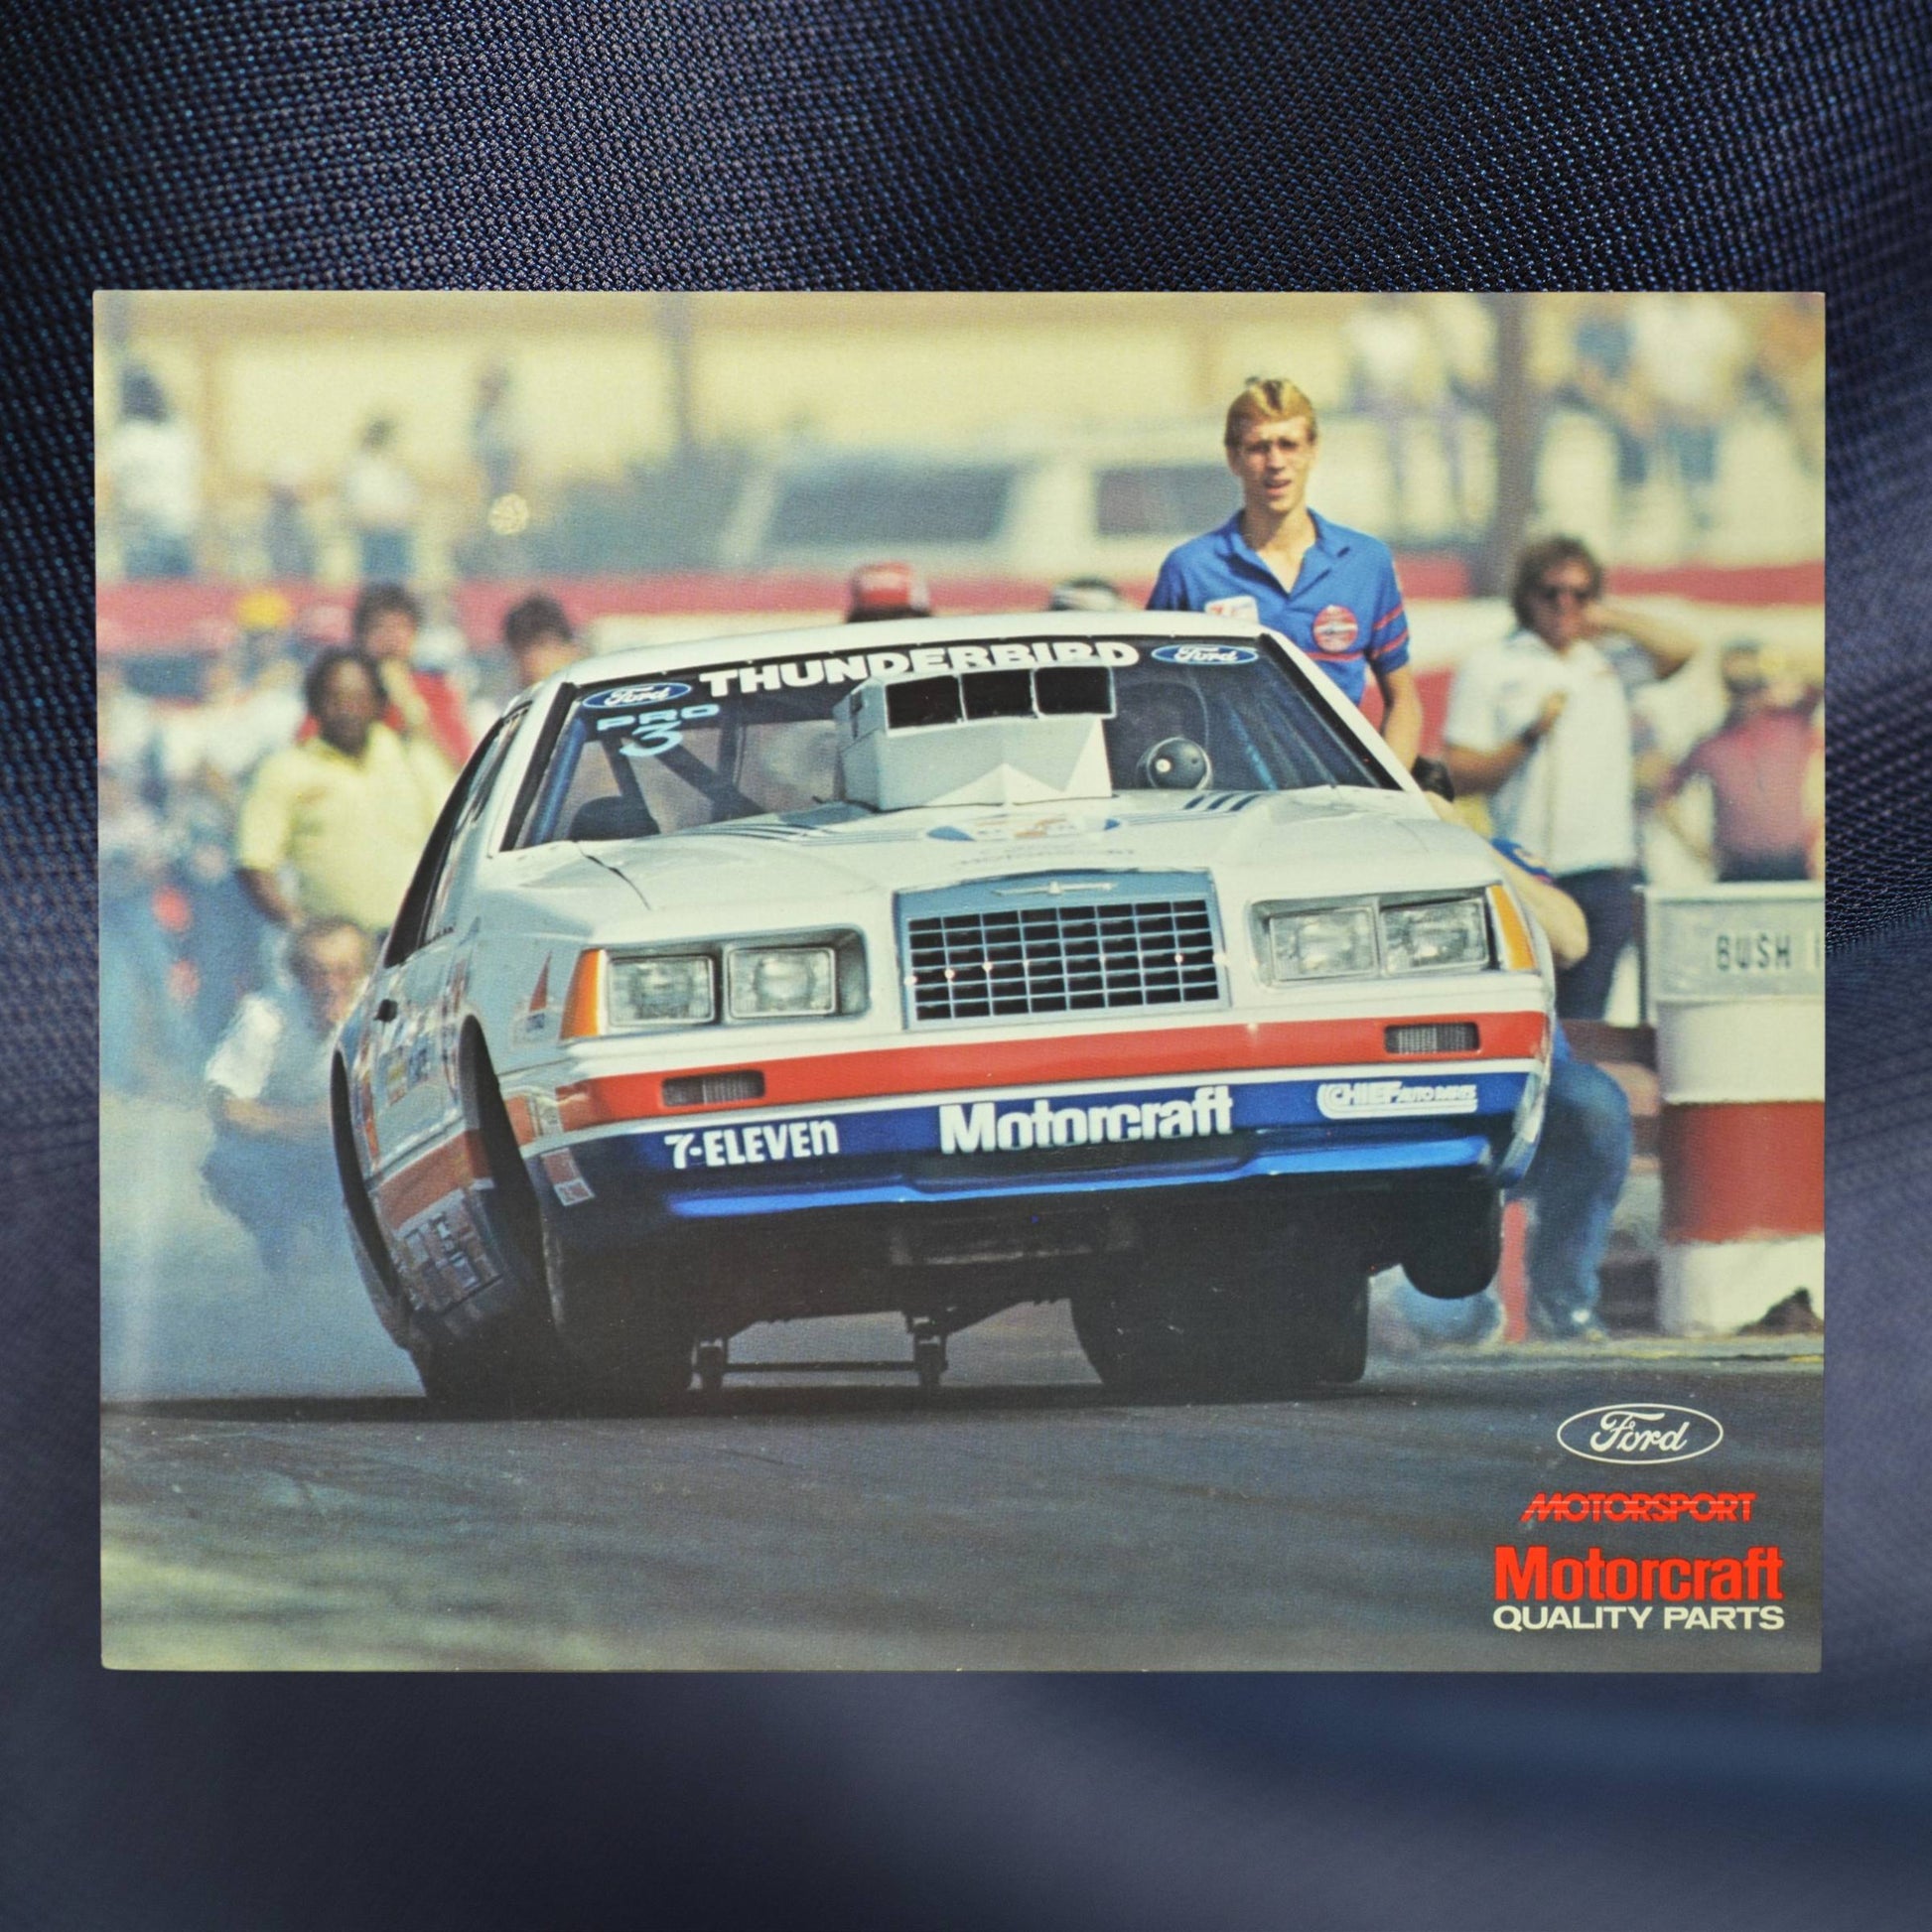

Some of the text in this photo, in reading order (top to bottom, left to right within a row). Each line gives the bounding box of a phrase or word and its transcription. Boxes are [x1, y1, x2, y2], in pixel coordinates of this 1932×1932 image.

[699, 642, 1140, 698] THUNDERBIRD
[1173, 645, 1239, 664] Ford
[604, 686, 671, 707] Ford
[597, 704, 720, 731] PRO
[619, 720, 683, 757] 3
[1716, 933, 1791, 971] BUSH
[938, 1085, 1233, 1155] Motorcraft
[1589, 1411, 1690, 1452] Ford
[1519, 1492, 1756, 1523] MOTORSPORT
[1494, 1545, 1784, 1601] Motorcraft
[1492, 1605, 1785, 1632] QUALITY PARTS
